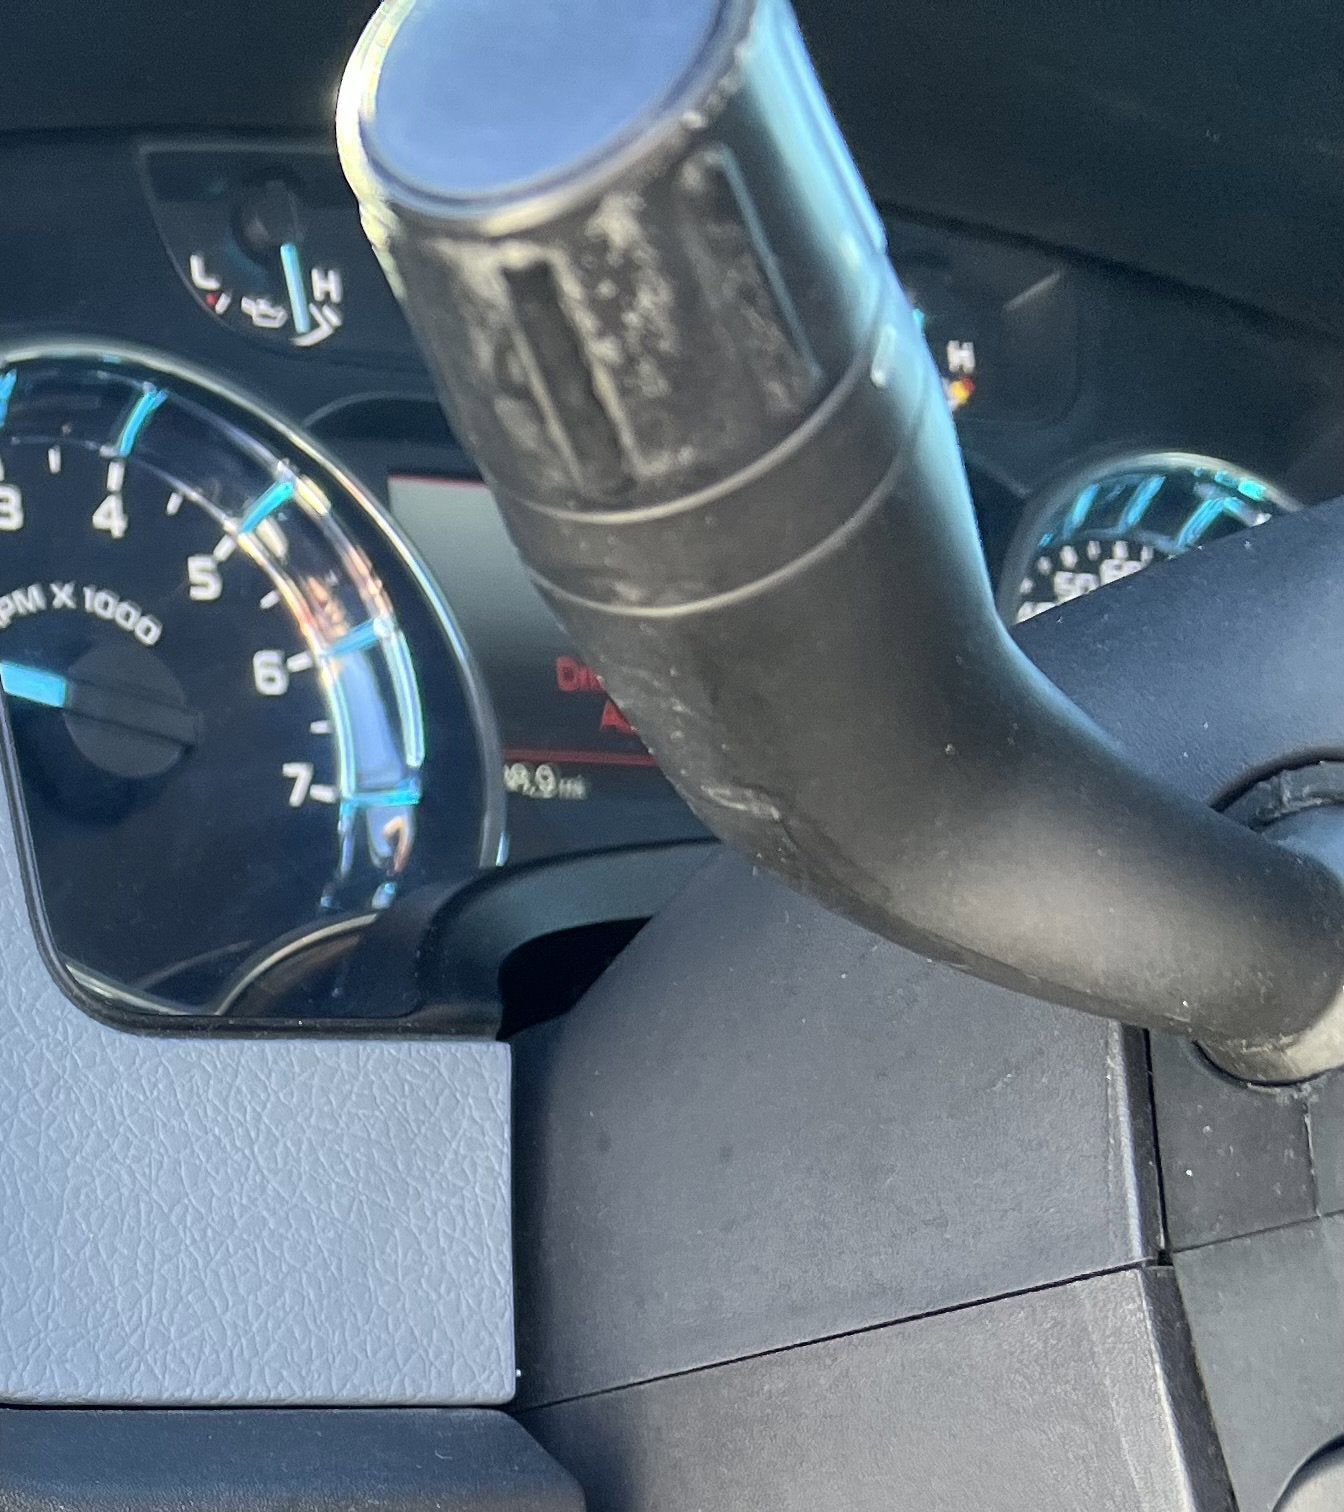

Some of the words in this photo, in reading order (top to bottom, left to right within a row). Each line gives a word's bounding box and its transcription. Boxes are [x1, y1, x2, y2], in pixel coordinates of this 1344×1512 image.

[190, 254, 220, 290] L
[312, 267, 342, 303] H
[947, 340, 976, 373] H
[92, 493, 128, 538] 4
[188, 554, 223, 601] 5
[50, 580, 77, 609] X
[83, 584, 163, 646] 1000
[253, 650, 289, 695] 6
[282, 762, 313, 807] 7
